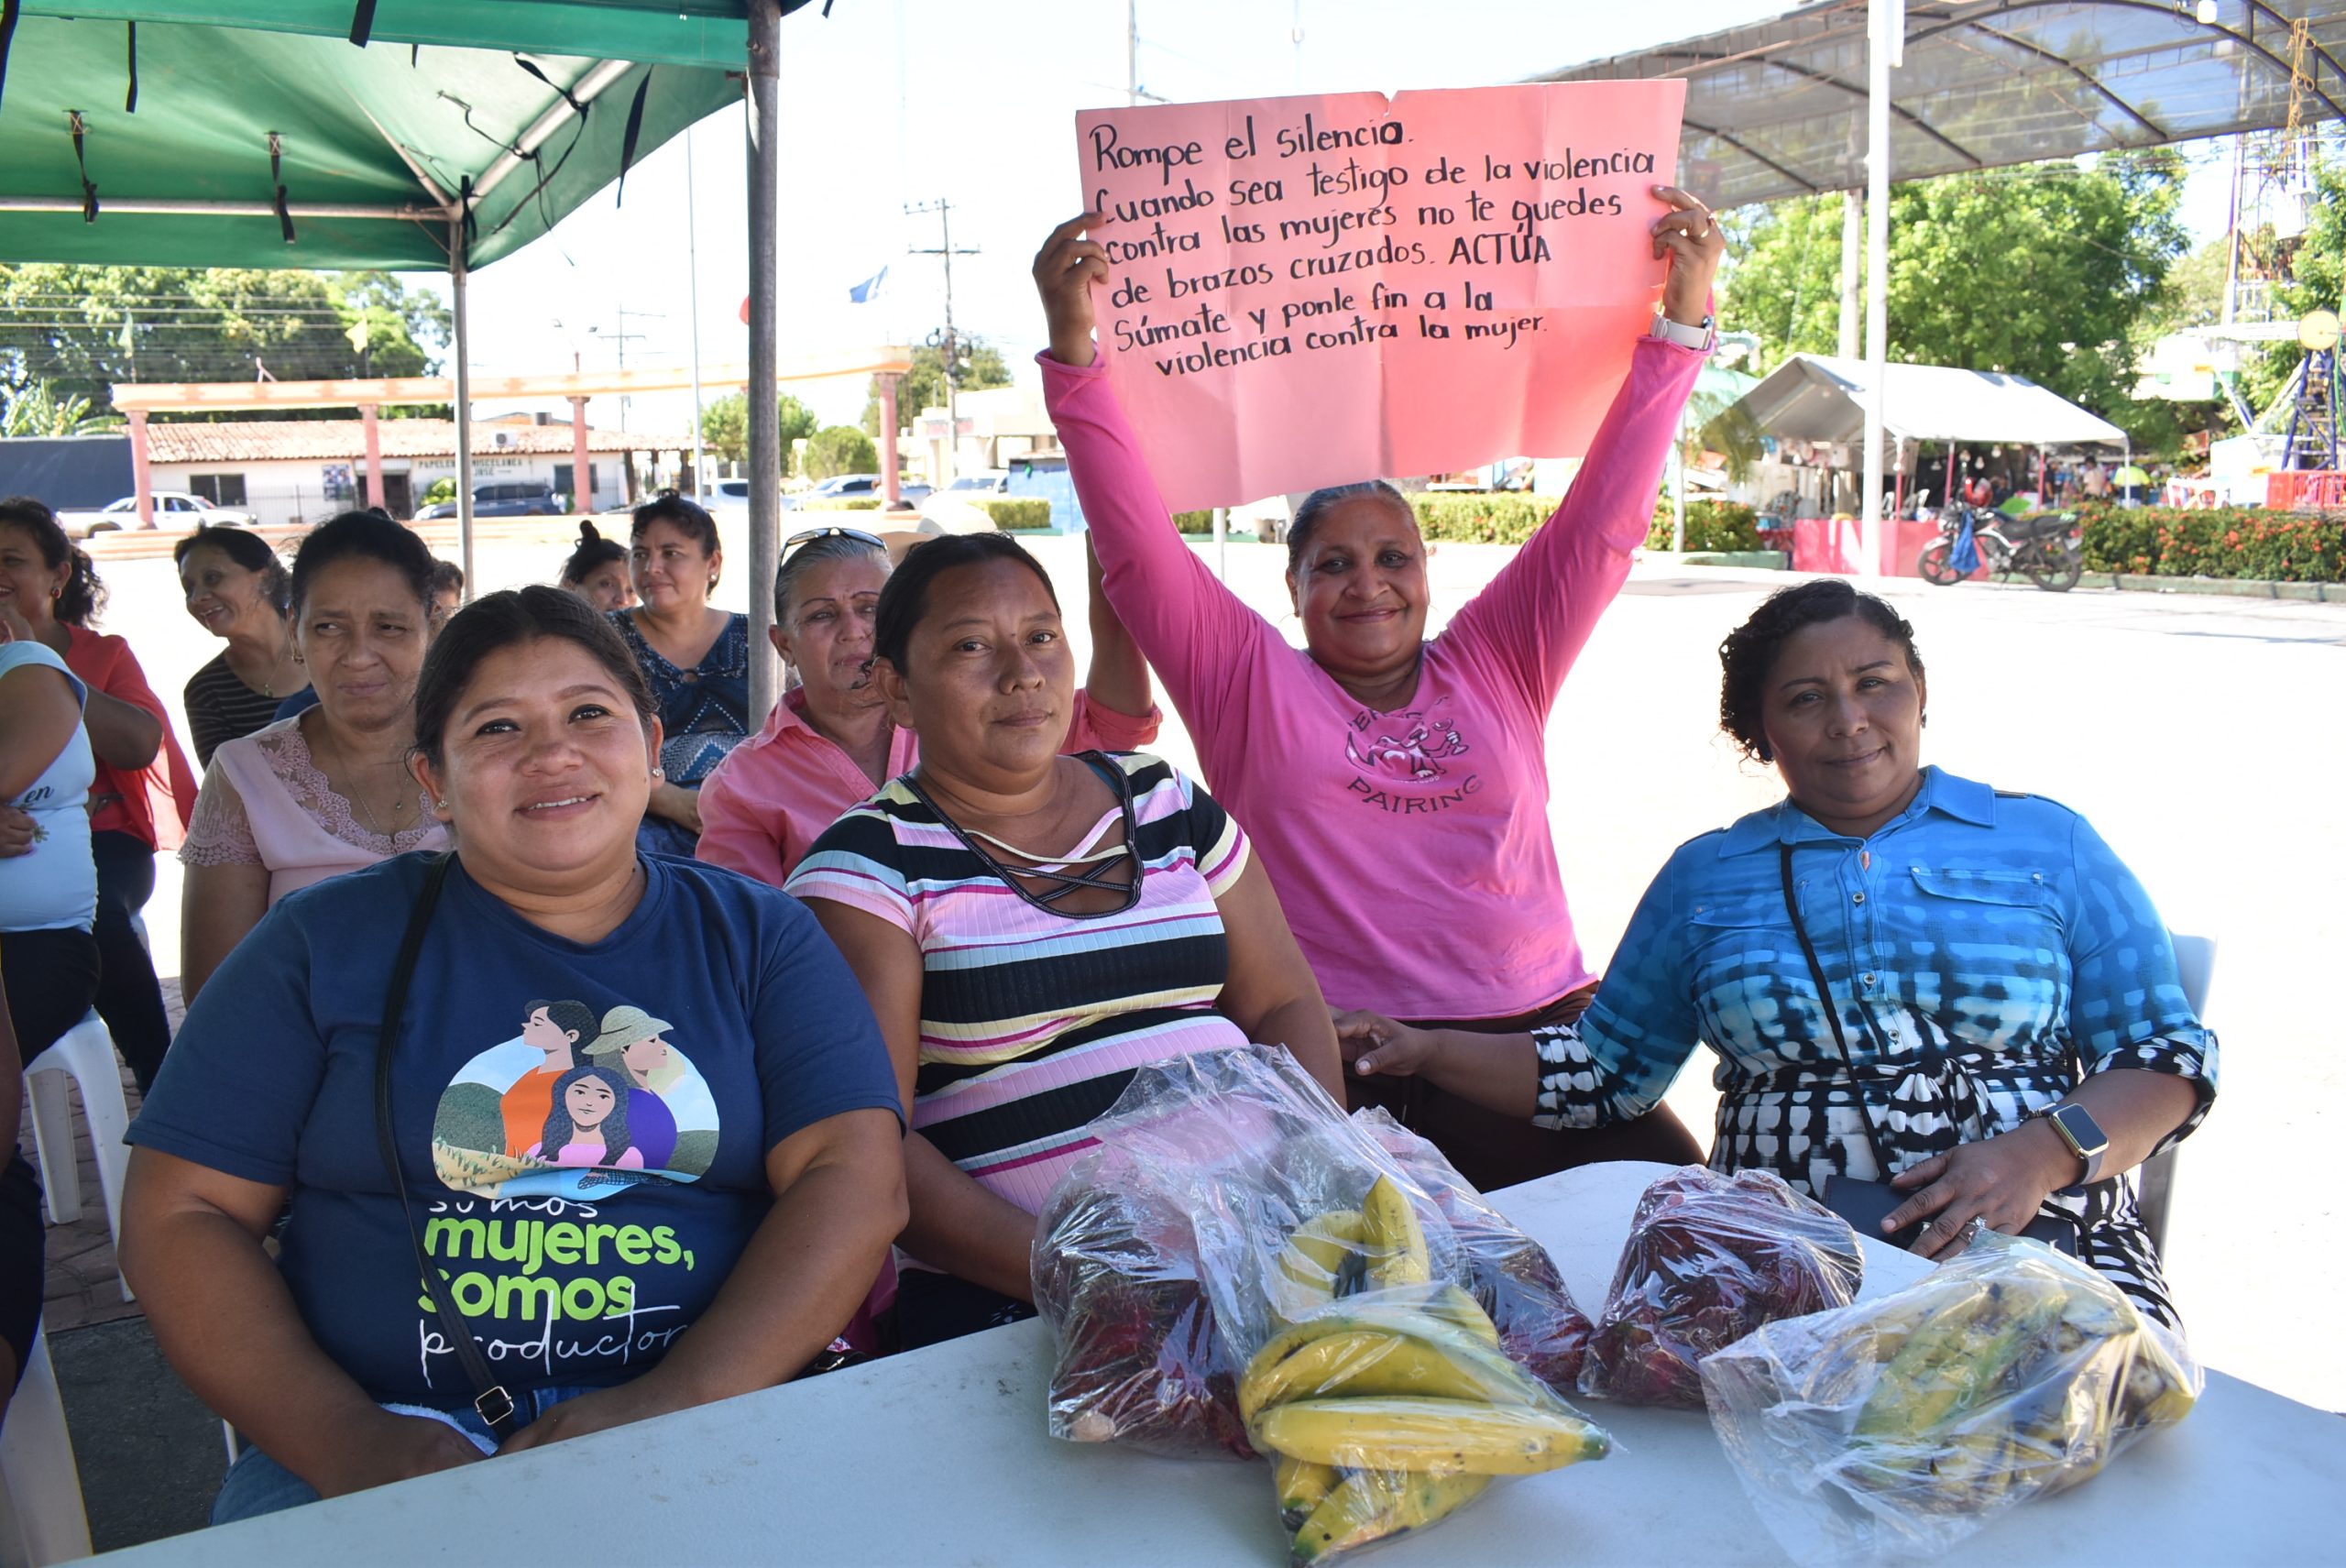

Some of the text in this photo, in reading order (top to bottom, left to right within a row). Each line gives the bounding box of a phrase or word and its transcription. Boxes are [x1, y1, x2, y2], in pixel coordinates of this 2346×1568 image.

[1089, 124, 1203, 186] Rompe
[1225, 115, 1256, 159] el
[1096, 148, 1654, 224] Cuando sea testigo de la violencia
[1105, 187, 1622, 265] contra las mujeres no te quedes
[1111, 222, 1552, 309] de brazos cruzados. ACTÚA
[1114, 281, 1493, 352] Súmate y ponle fin a la
[1155, 314, 1548, 376] violencia contra la mujer.
[423, 1217, 695, 1275] mujeres,
